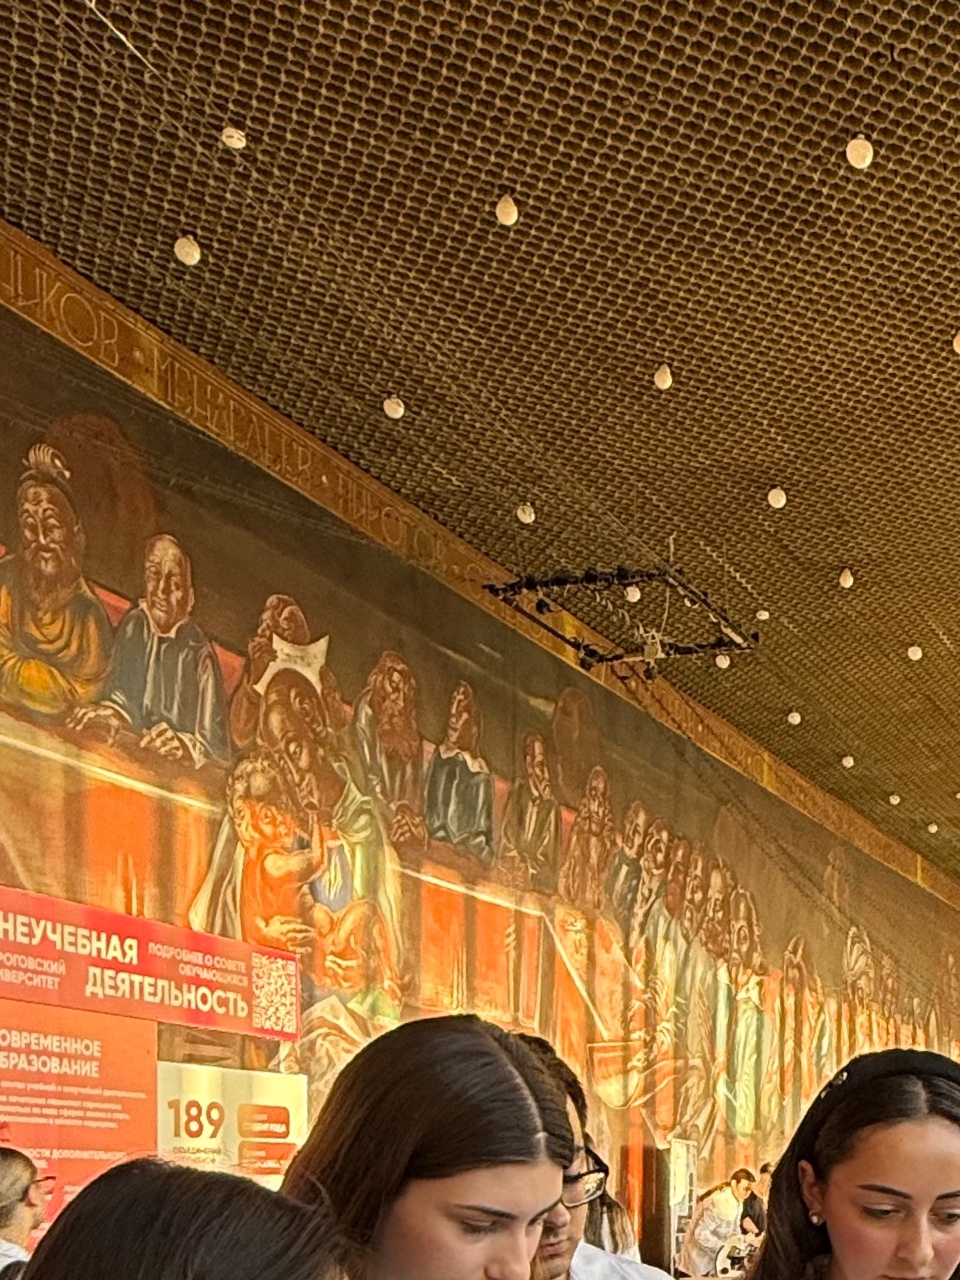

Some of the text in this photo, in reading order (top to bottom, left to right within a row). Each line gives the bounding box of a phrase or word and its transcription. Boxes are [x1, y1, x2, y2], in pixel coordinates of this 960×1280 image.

[148, 941, 247, 974] ПОДРОБНЕЕ О СОВЕТЕ
[85, 965, 249, 1018] ДЕЯТЕЛЬНОСТЬ
[0, 1028, 102, 1057] ОВРЕМЕННОЕ
[167, 1098, 225, 1139] 189
